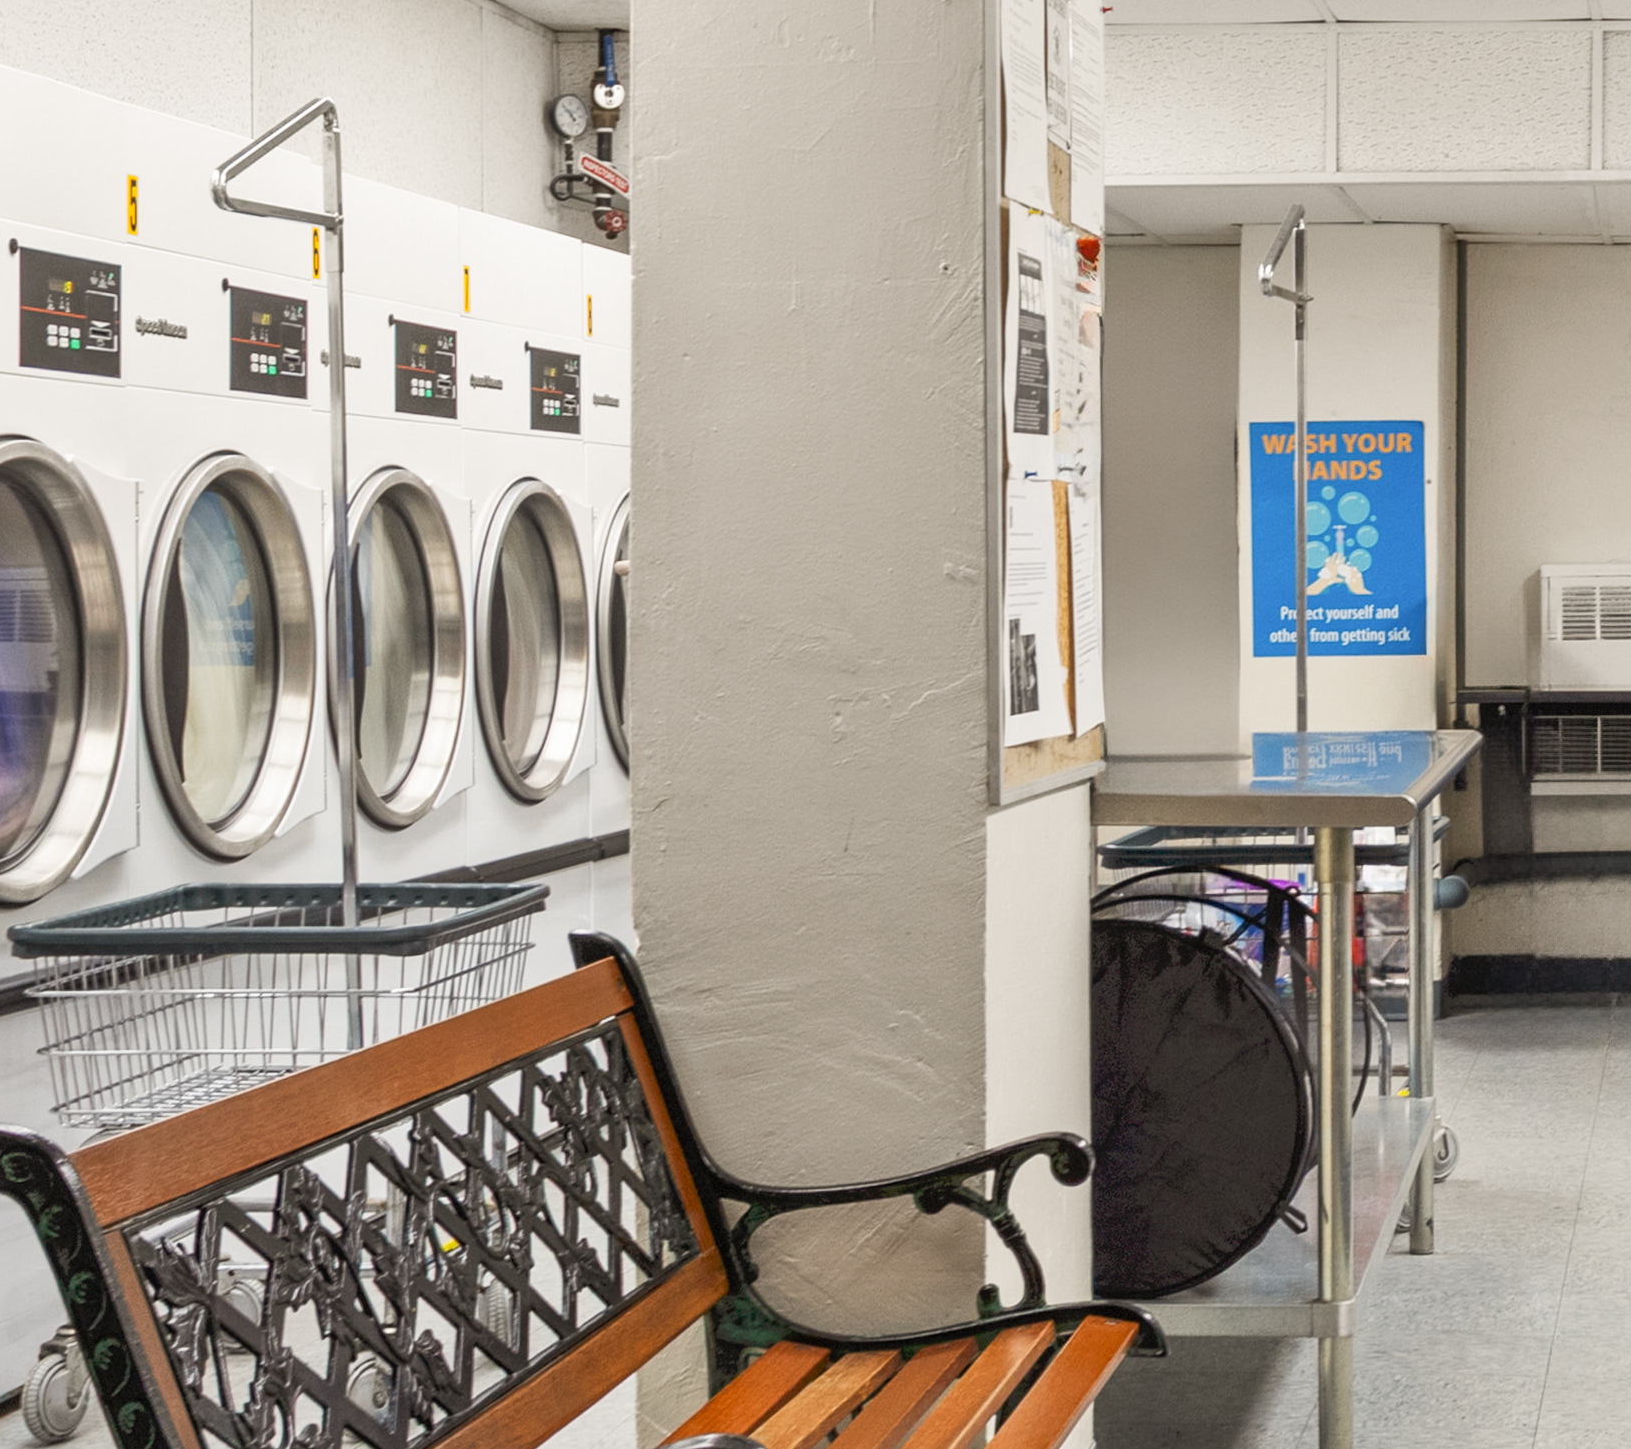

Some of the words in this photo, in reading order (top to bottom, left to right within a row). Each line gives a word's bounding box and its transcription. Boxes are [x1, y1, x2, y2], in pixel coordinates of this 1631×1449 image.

[1341, 433, 1413, 454] YOUR
[1280, 606, 1324, 620] Proect
[1325, 604, 1374, 624] yourself
[1375, 604, 1399, 619] and
[1309, 628, 1339, 643] from
[1341, 627, 1386, 646] getting
[1387, 627, 1411, 641] sick
